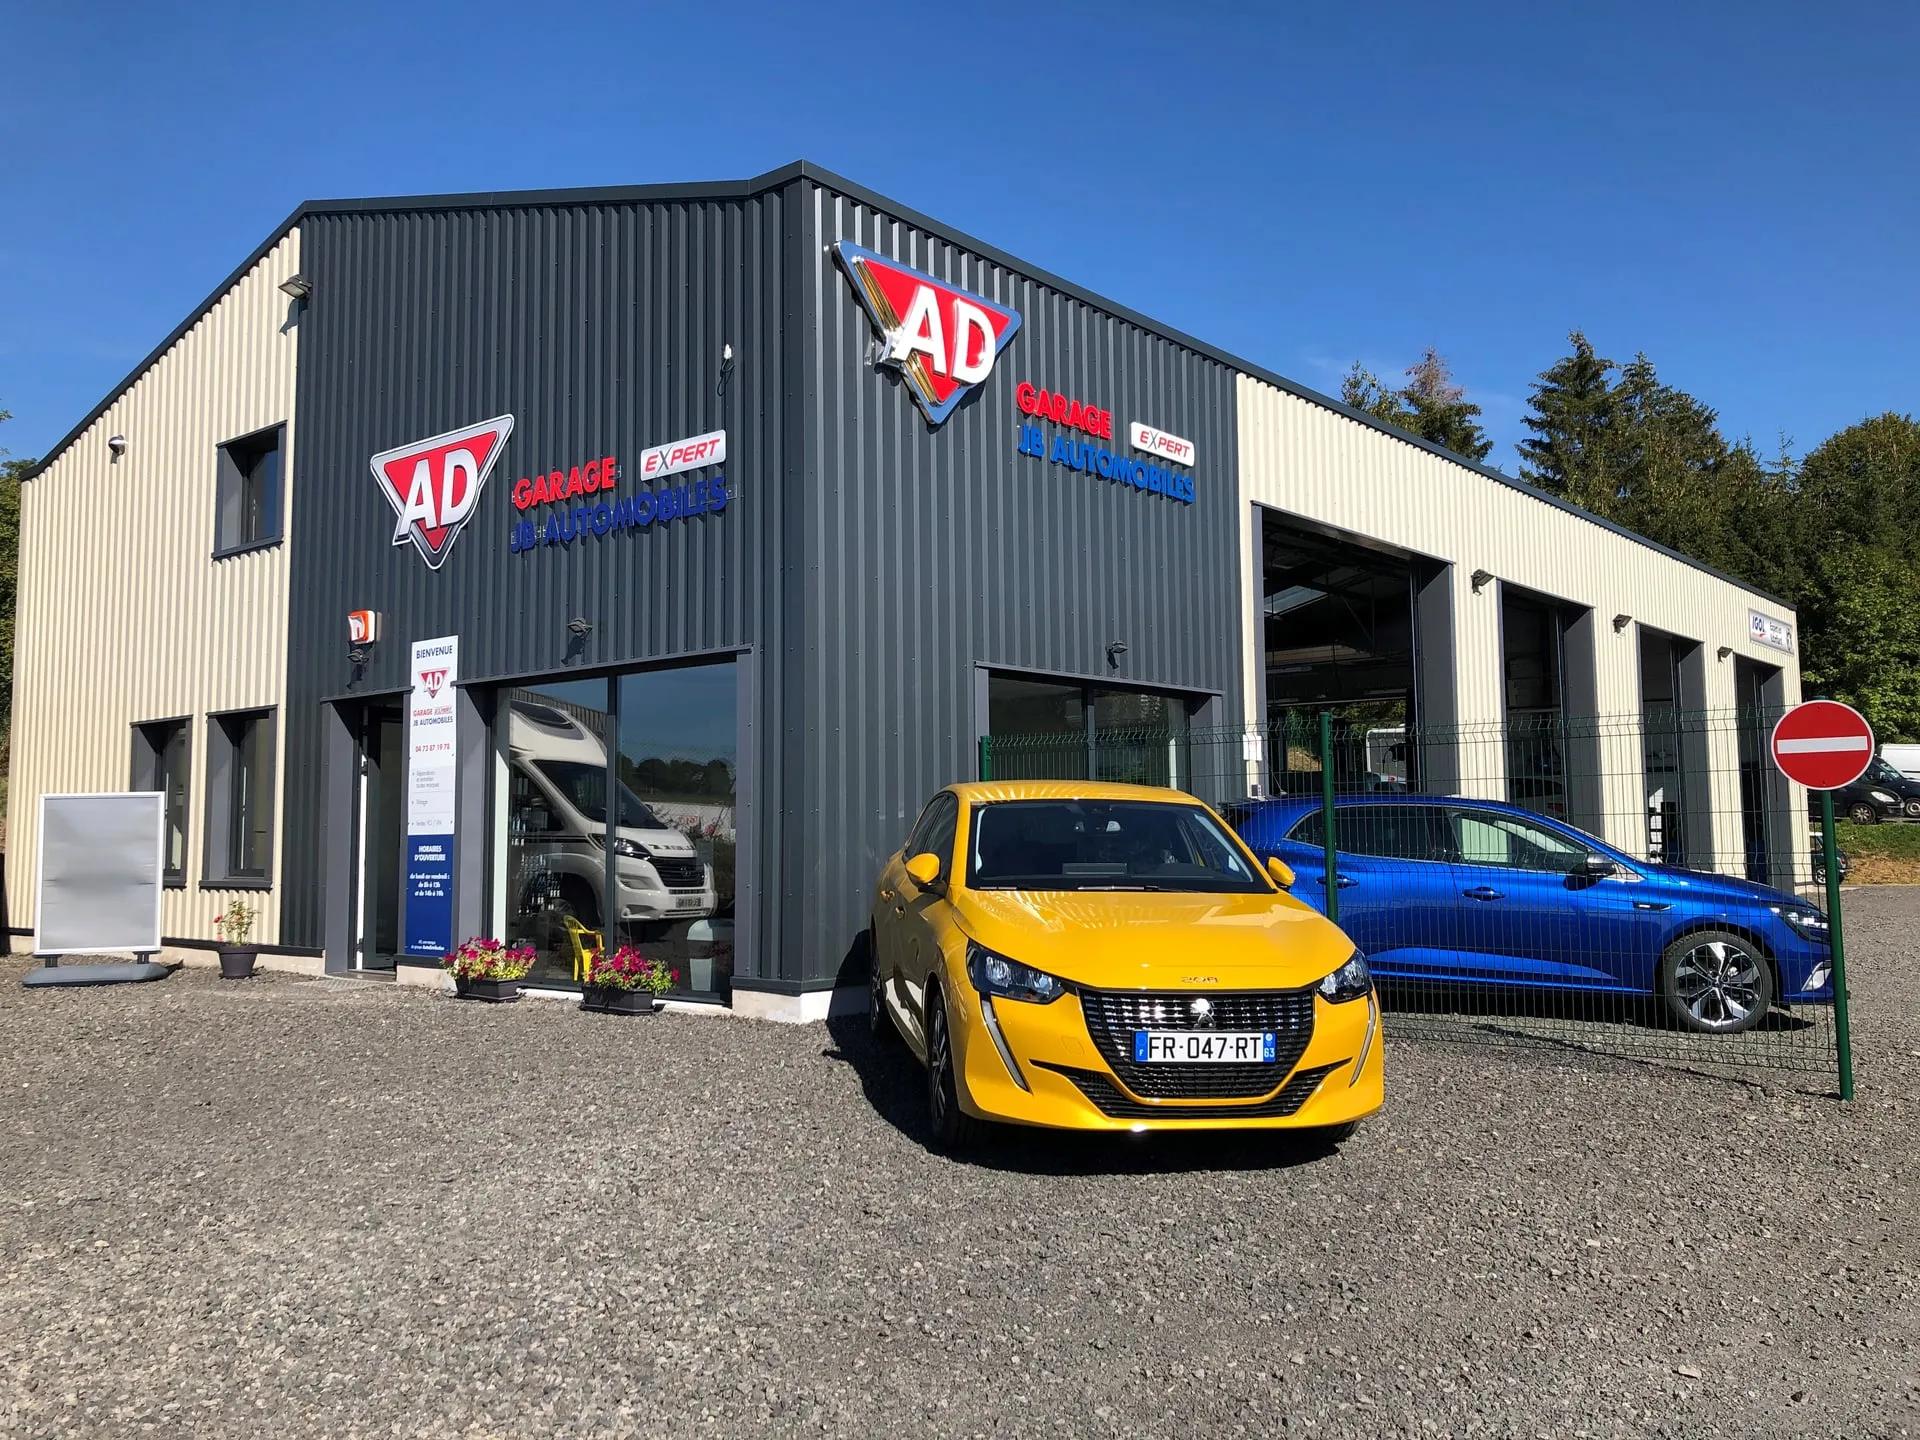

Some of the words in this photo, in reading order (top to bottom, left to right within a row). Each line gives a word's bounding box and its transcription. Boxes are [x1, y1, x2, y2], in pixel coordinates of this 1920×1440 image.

[893, 285, 996, 385] AD
[1016, 382, 1112, 440] GARAGE
[645, 438, 720, 473] EXPERT
[1139, 430, 1191, 459] EXPERT
[1017, 424, 1045, 457] JB
[1050, 436, 1195, 504] AUTOMOBILES
[397, 448, 478, 537] AD
[513, 456, 618, 510] GARAGE
[511, 519, 536, 552] JB
[543, 476, 727, 544] AUTOMOBILES
[1752, 615, 1765, 633] IGOL
[416, 645, 453, 660] BIENVENUE
[424, 671, 443, 691] AD
[413, 708, 433, 717] GARAGE
[419, 716, 454, 726] AUTOMOBILES
[414, 853, 446, 861] D'OUVERTURE
[418, 845, 442, 853] HORAIRES
[1148, 1036, 1262, 1060] FR-047-RT
[1264, 1047, 1275, 1058] 63
